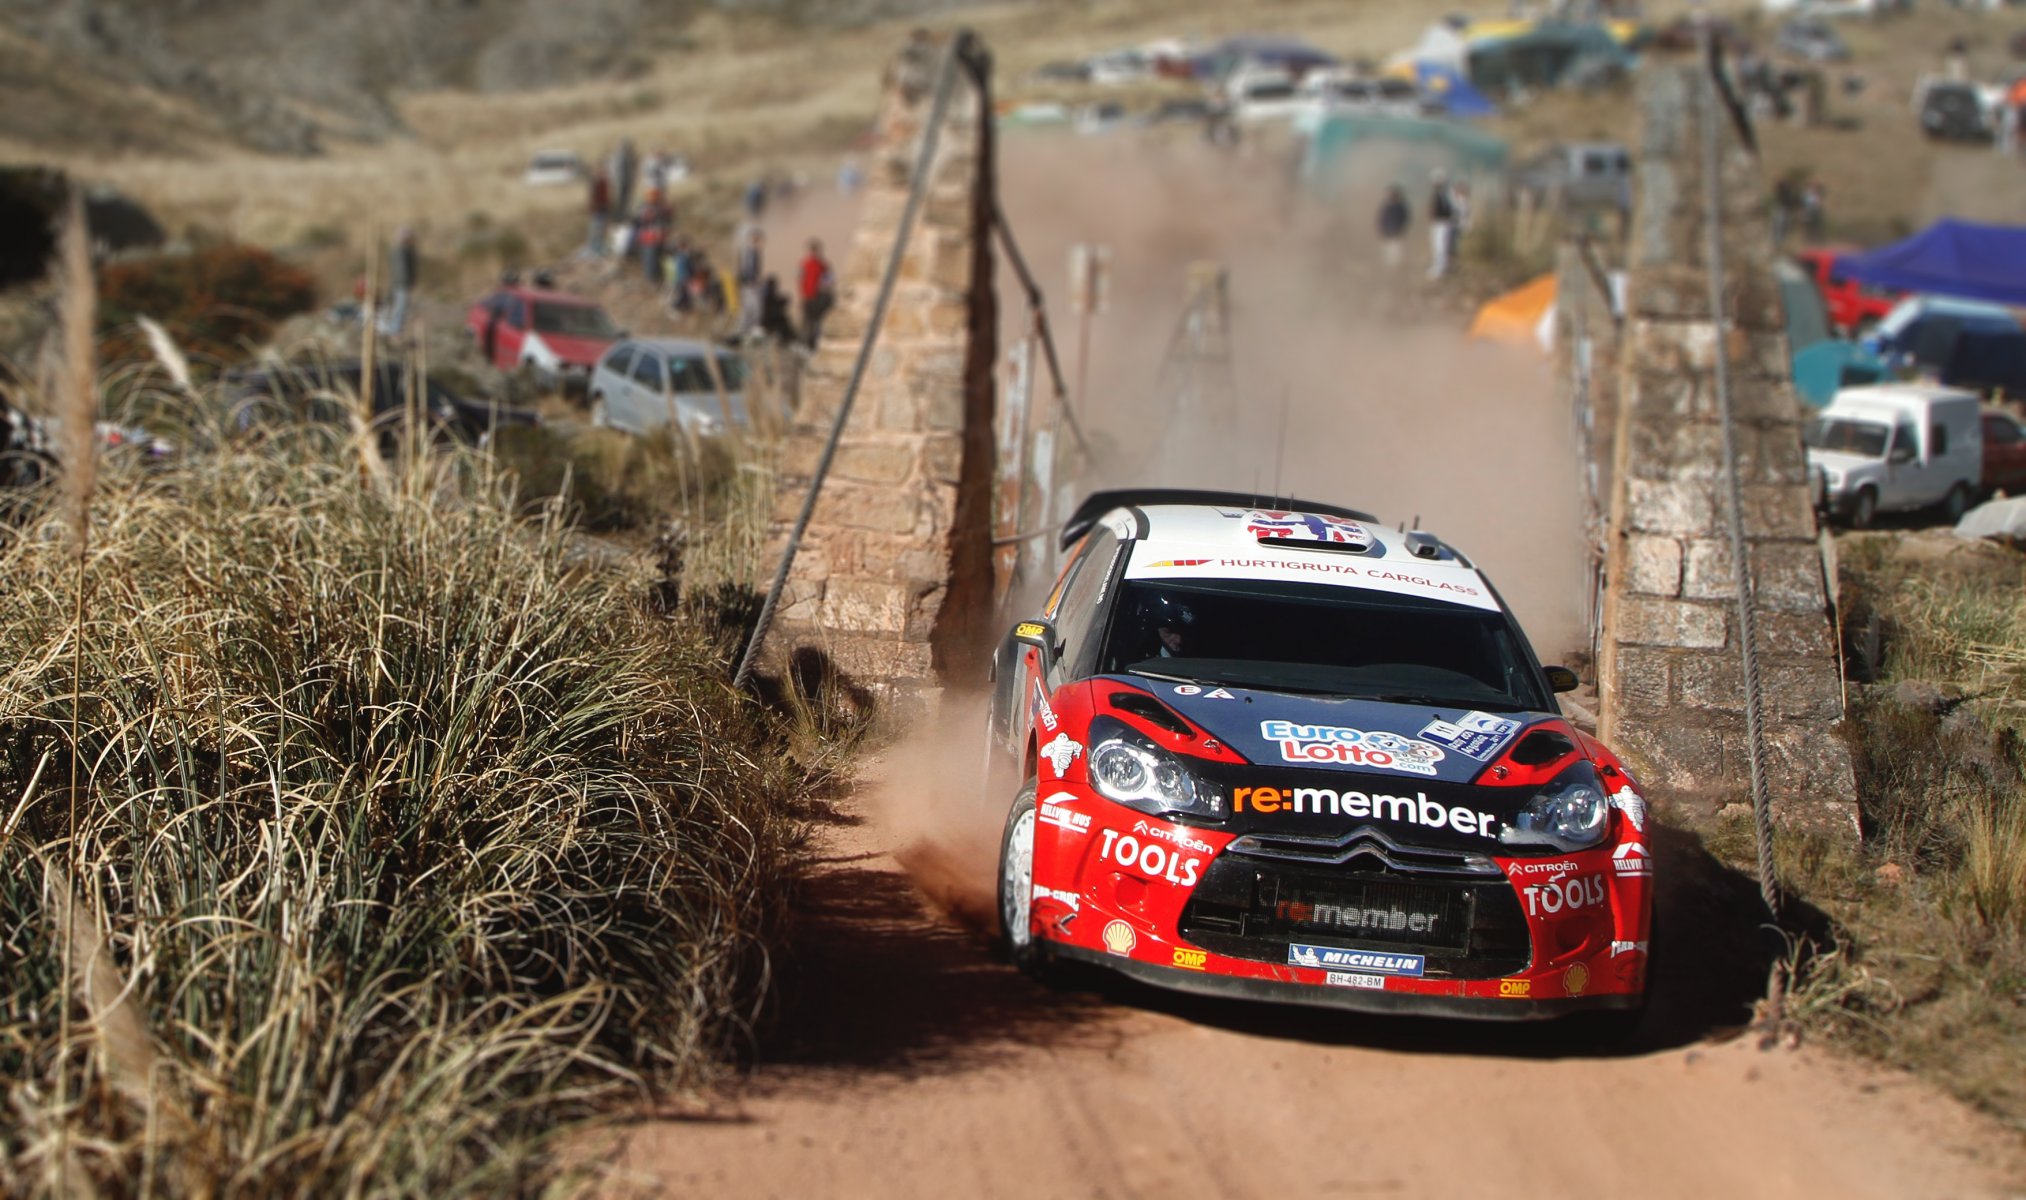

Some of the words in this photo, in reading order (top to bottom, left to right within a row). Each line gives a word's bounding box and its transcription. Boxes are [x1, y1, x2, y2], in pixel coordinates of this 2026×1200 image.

[1221, 558, 1359, 575] HURTIGRUTA
[1366, 570, 1480, 596] CARGLASS
[1016, 624, 1044, 636] OMP
[1266, 722, 1361, 742] Euro
[1286, 741, 1393, 765] Lotto
[1072, 813, 1092, 828] HUS
[1234, 787, 1496, 838] re:member
[1101, 829, 1200, 887] TOOLS
[1523, 874, 1604, 916] TOOLS
[1276, 900, 1439, 932] re:member
[1173, 950, 1207, 966] OMP
[1322, 951, 1419, 970] MICHELIN
[1329, 973, 1382, 987] BH-482-BM
[1500, 981, 1530, 995] OMP
